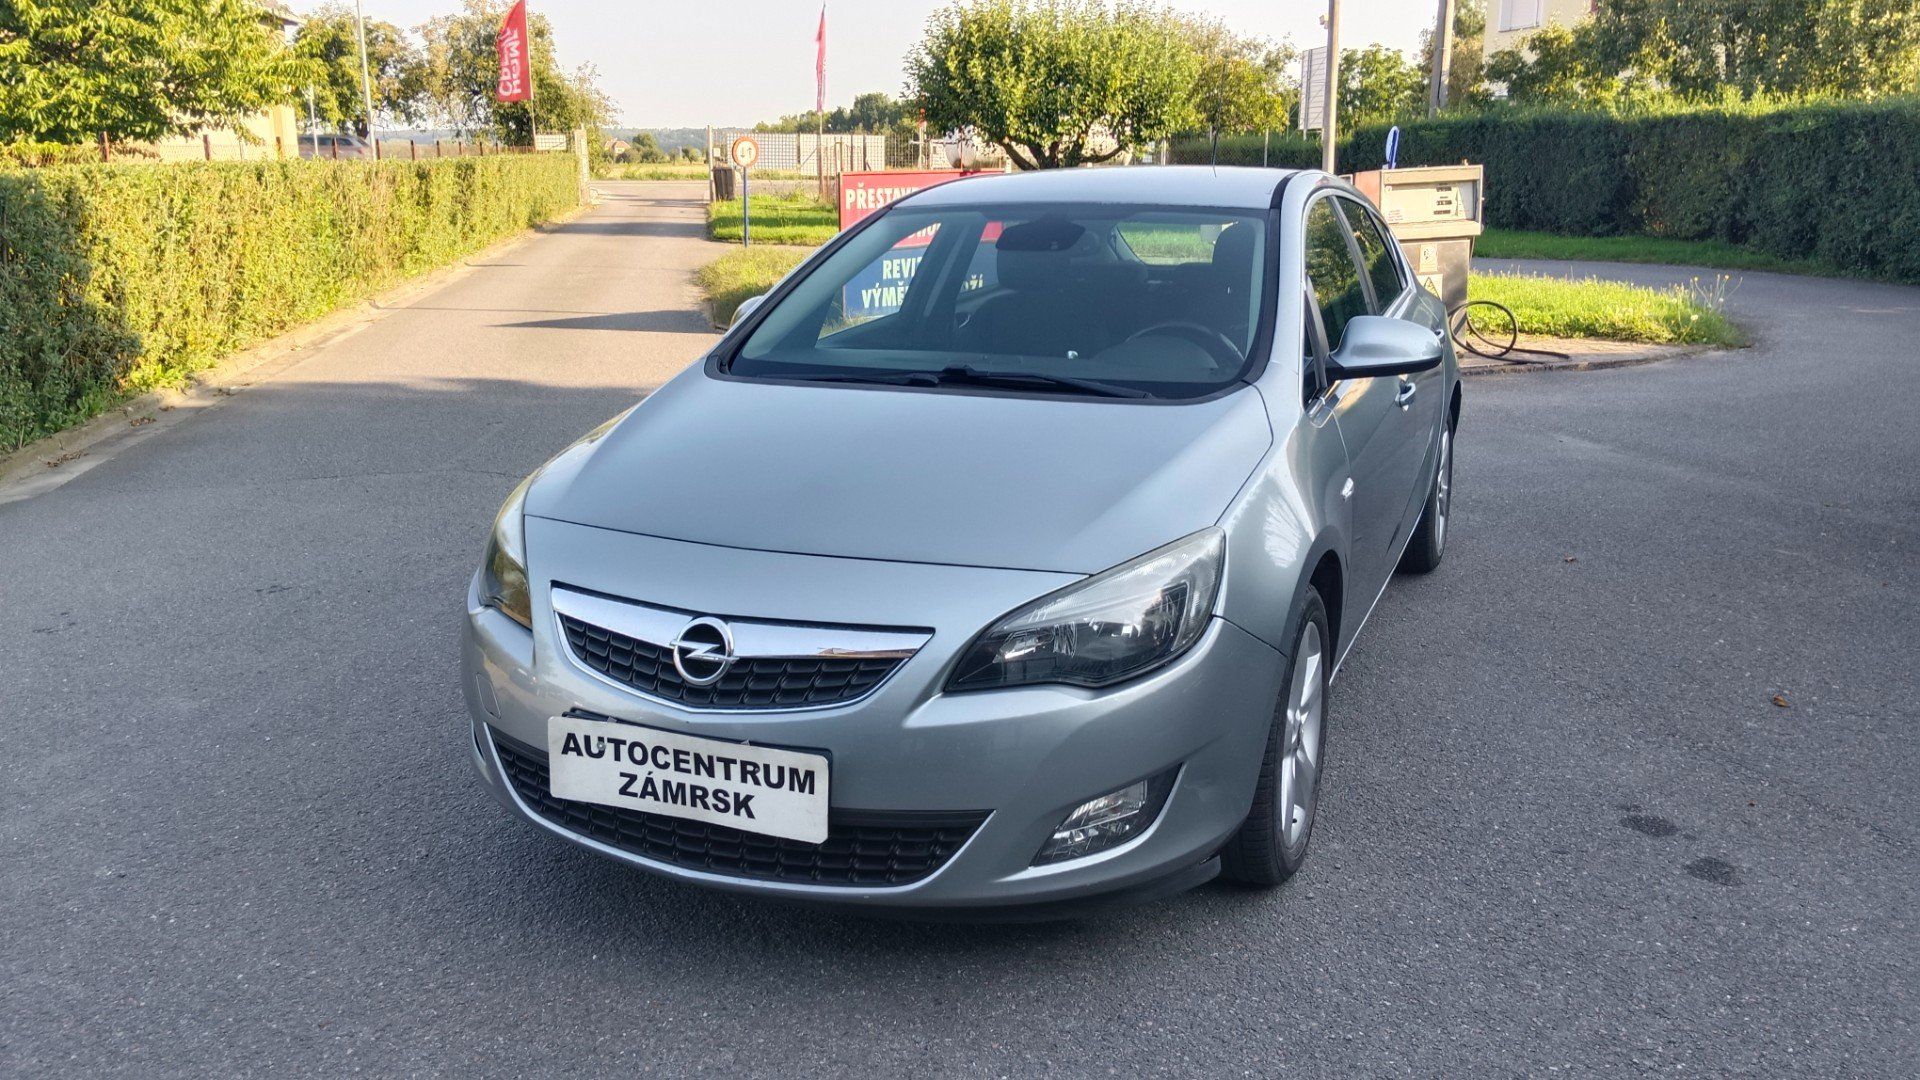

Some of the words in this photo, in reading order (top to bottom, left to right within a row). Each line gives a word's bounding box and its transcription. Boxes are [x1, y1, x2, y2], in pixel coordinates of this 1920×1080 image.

[882, 256, 922, 280] REVI
[561, 732, 815, 795] AUTOCENTRUM
[618, 771, 756, 819] ZÁMRSK
